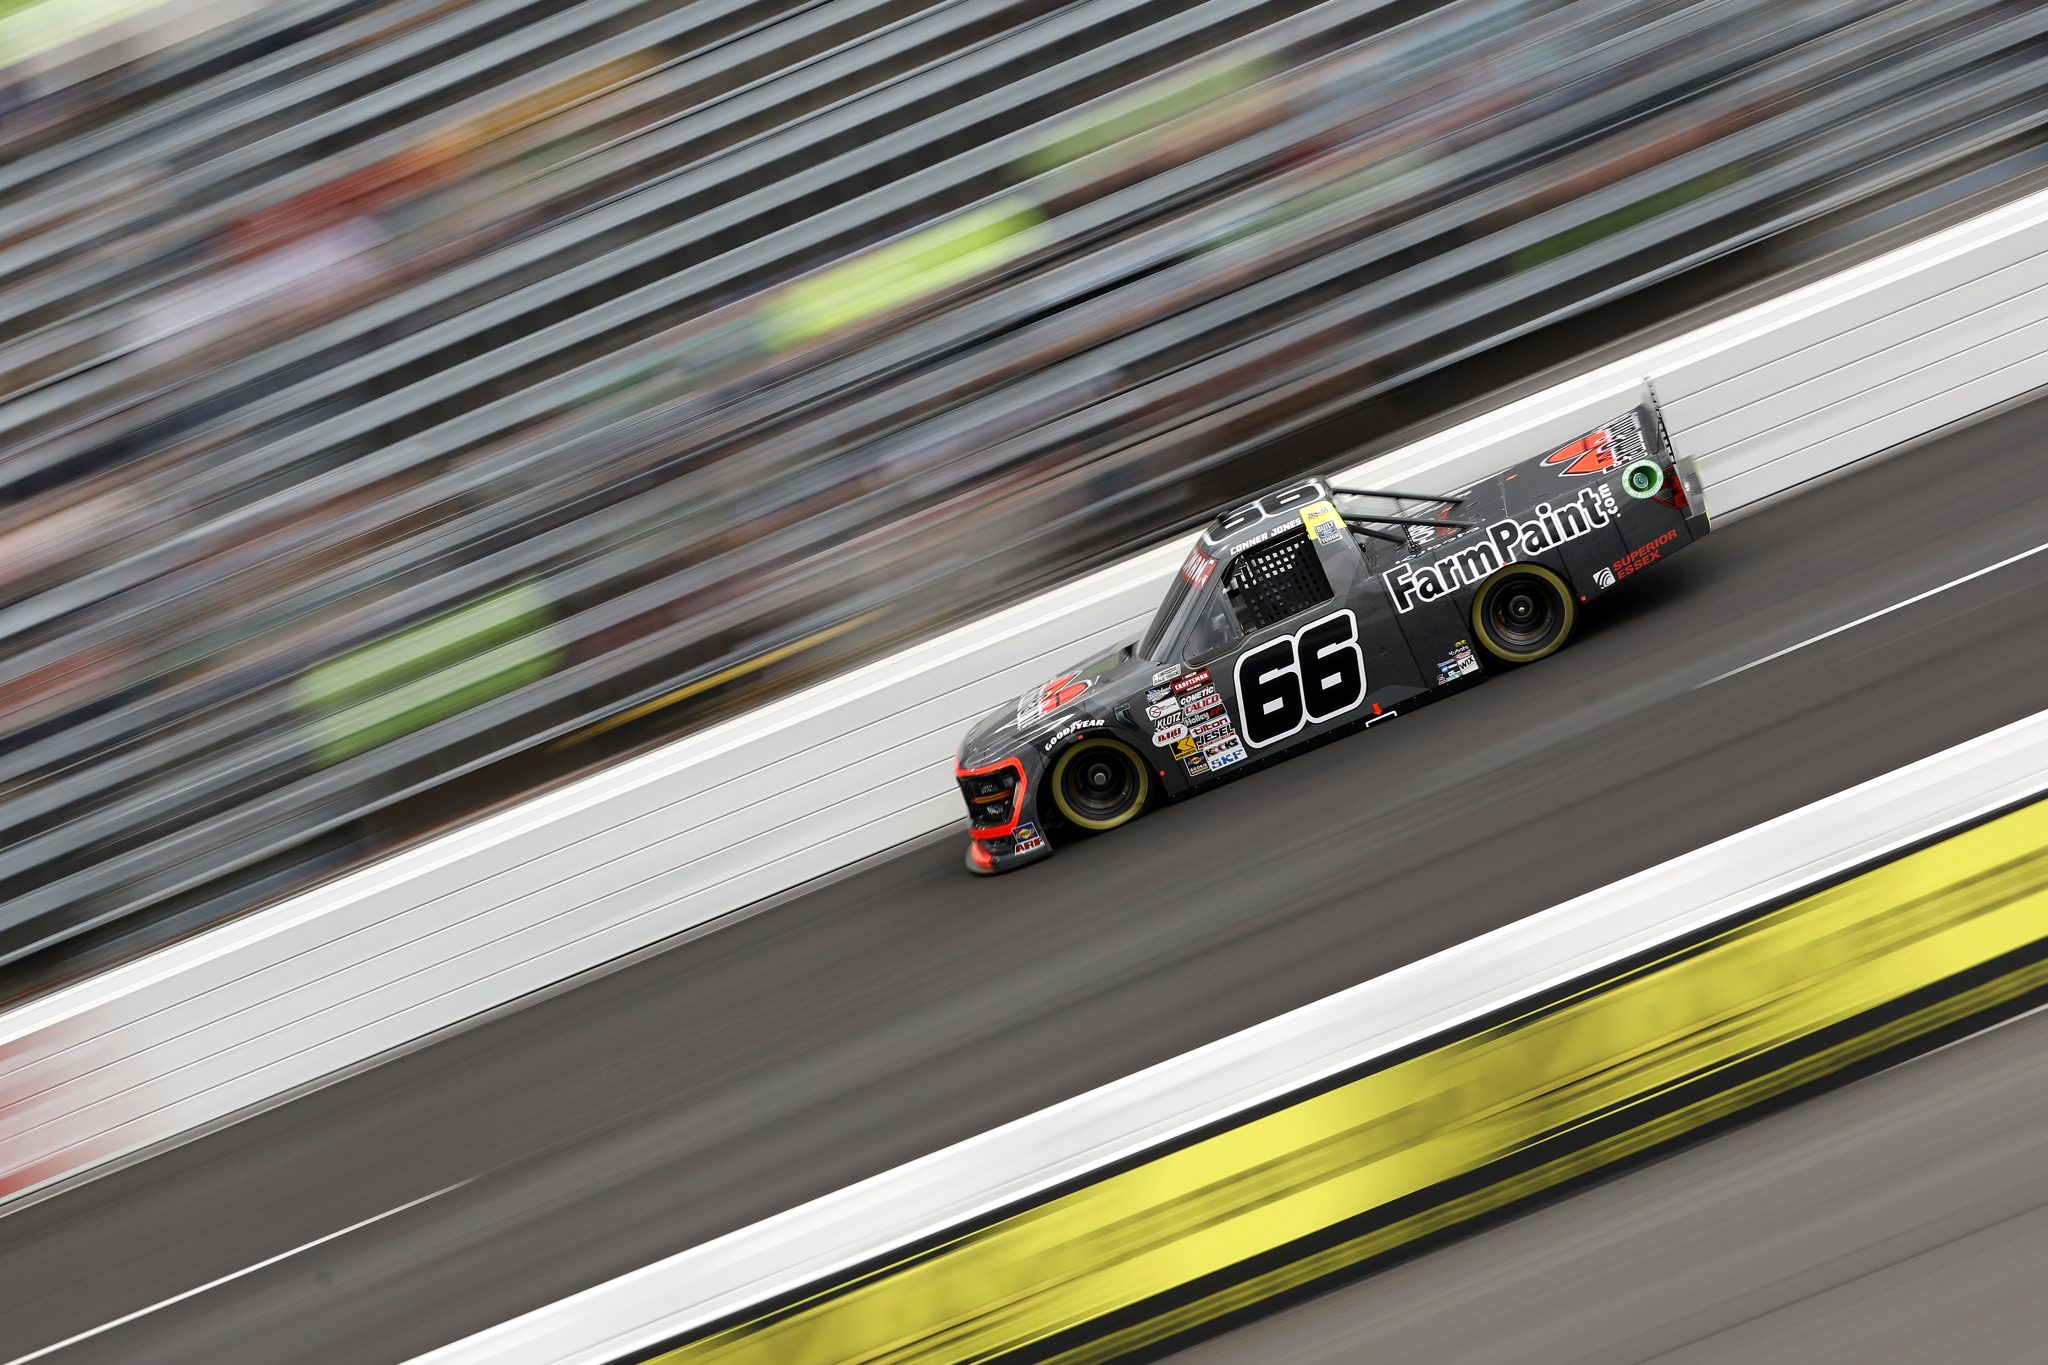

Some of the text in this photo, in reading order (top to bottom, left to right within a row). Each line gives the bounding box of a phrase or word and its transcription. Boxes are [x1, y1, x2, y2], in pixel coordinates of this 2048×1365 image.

[1230, 532, 1269, 555] CONNER
[1270, 517, 1302, 536] JONES
[1316, 521, 1334, 533] BUILT
[1320, 533, 1340, 544] TOUGH
[1382, 487, 1610, 614] FarmPaint
[1612, 528, 1678, 572] SUPERIOR
[1617, 549, 1661, 580] ESSEX
[1459, 655, 1475, 670] WIX
[1174, 672, 1209, 690] CRAFTSMAN
[1233, 608, 1367, 749] 66
[1180, 685, 1214, 705] COMETIC
[1185, 694, 1220, 715] CALICO
[1157, 711, 1182, 729] KLOTZ
[1192, 717, 1228, 735] tilton
[1044, 719, 1105, 751] GOODYEAR
[1197, 724, 1234, 745] JESEL
[1205, 738, 1239, 758] KOOKS
[1211, 748, 1243, 769] SKF
[1015, 838, 1042, 853] ARP
